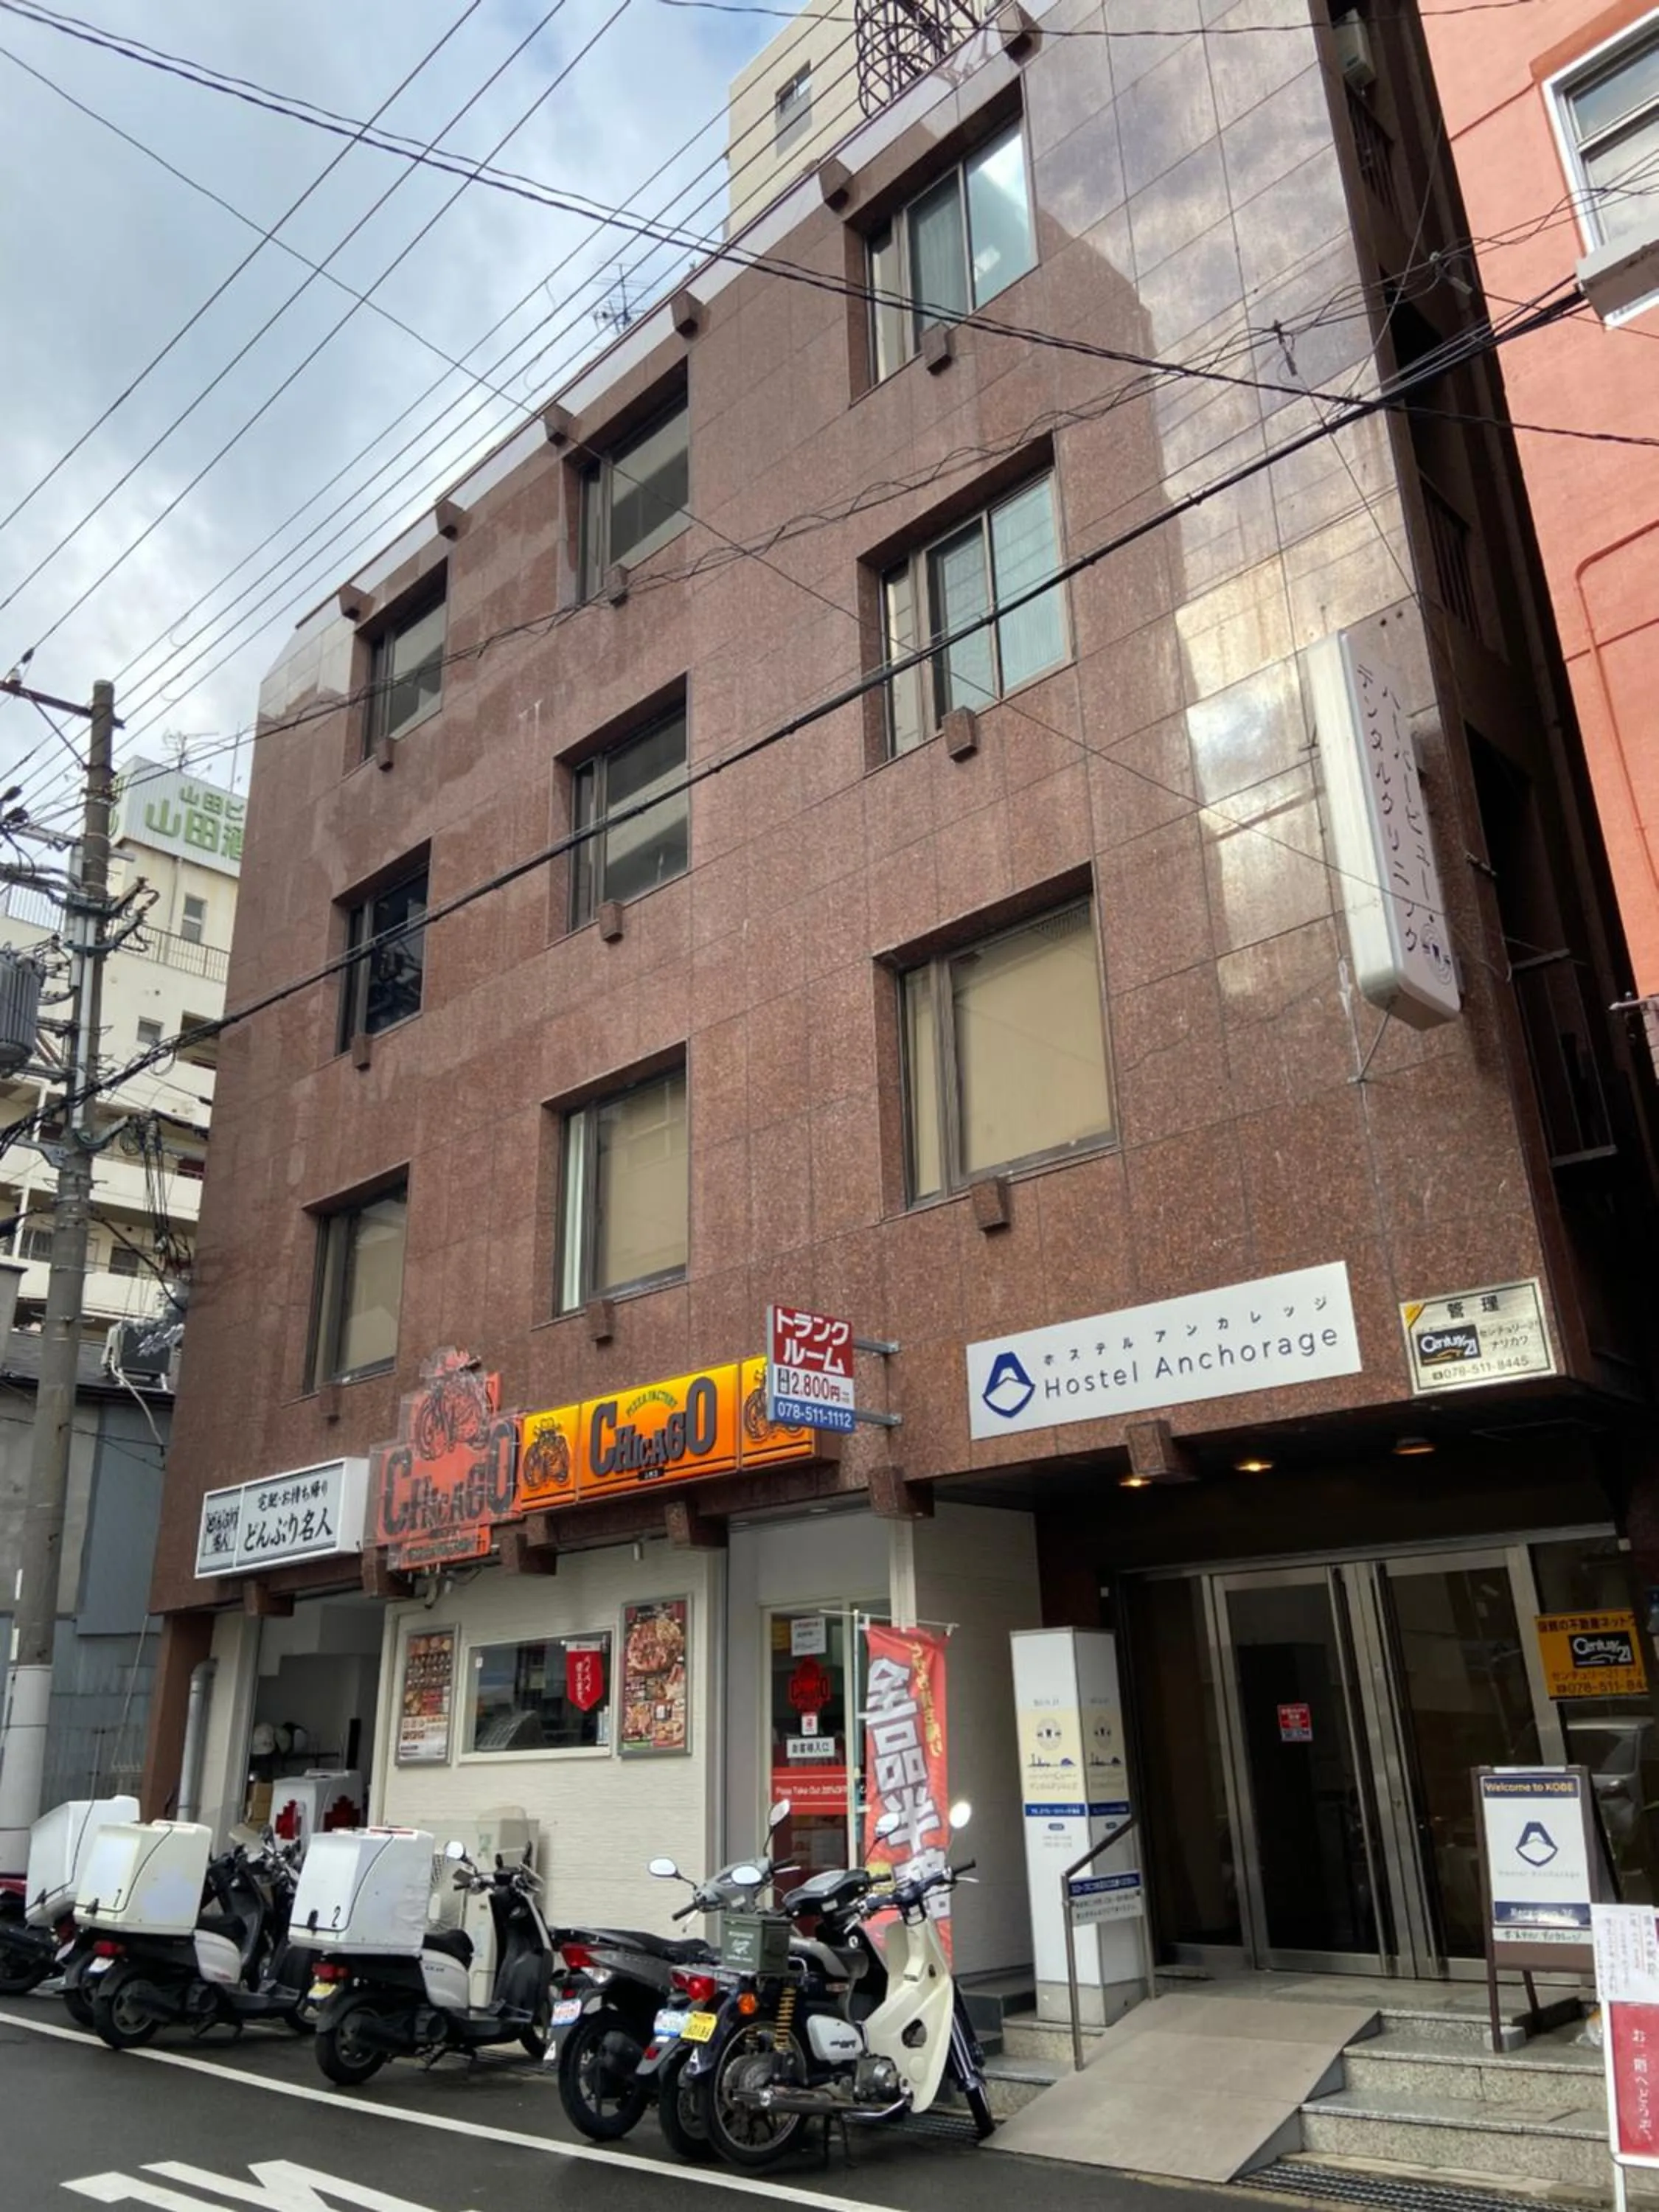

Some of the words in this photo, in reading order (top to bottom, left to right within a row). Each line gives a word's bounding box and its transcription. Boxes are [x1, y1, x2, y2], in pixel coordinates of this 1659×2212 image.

[1446, 1295, 1500, 1319] 管理
[776, 1308, 849, 1346] トランク
[1044, 1295, 1327, 1366] ホステルアンカレッジ
[783, 1338, 845, 1375] ルーム
[1044, 1361, 1139, 1399] Hostel
[1155, 1328, 1338, 1379] Anchorage
[591, 1376, 717, 1478] CHICAGO
[777, 1402, 852, 1429] 078-511-1112
[243, 1507, 333, 1551] どんぶり名人
[1485, 1781, 1531, 1792] Welcome
